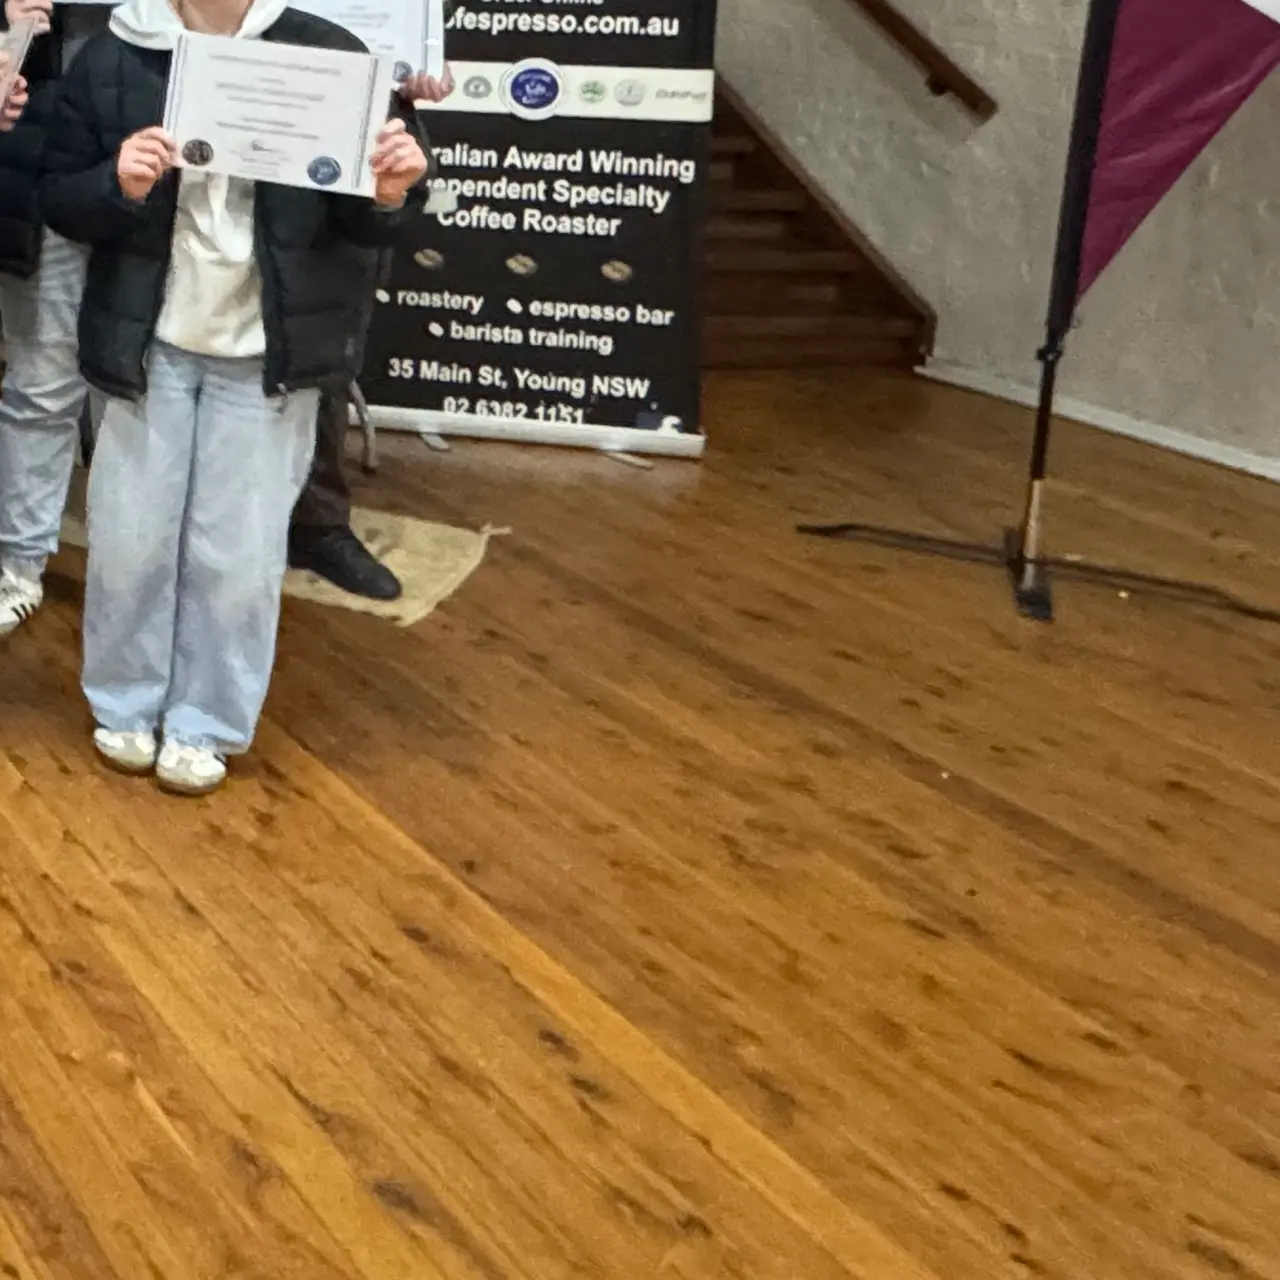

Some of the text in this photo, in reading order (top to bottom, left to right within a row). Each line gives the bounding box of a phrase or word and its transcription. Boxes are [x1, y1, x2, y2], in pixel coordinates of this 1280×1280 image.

[431, 142, 696, 184] ralian Award Winning
[426, 176, 671, 215] ependent Specialty
[437, 204, 622, 237] Coffee Roaster
[397, 290, 675, 325] roastery espresso bar
[450, 320, 614, 356] barista training
[388, 357, 651, 399] 35 Main St, Young NSW
[443, 396, 470, 415] 02
